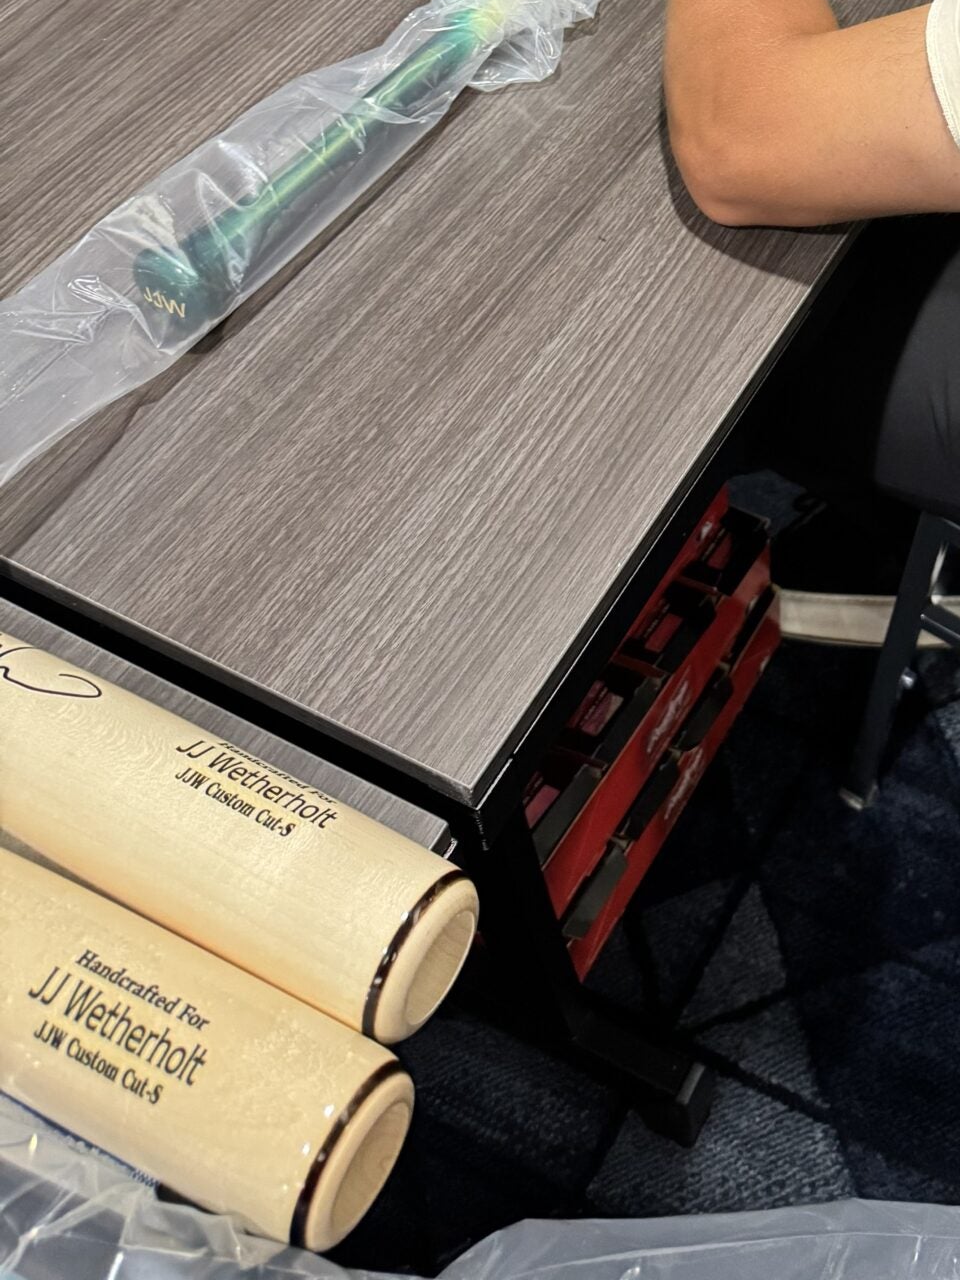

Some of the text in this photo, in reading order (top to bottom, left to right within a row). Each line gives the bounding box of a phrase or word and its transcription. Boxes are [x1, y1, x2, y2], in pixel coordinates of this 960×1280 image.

[175, 768, 297, 837] JJW Custom Cut-S
[176, 740, 338, 829] JJ Wetherholt
[28, 966, 208, 1086] JJ Wetherholt
[75, 949, 210, 1031] Handcrafted For
[34, 1020, 164, 1105] JJW Custom Cut-S
